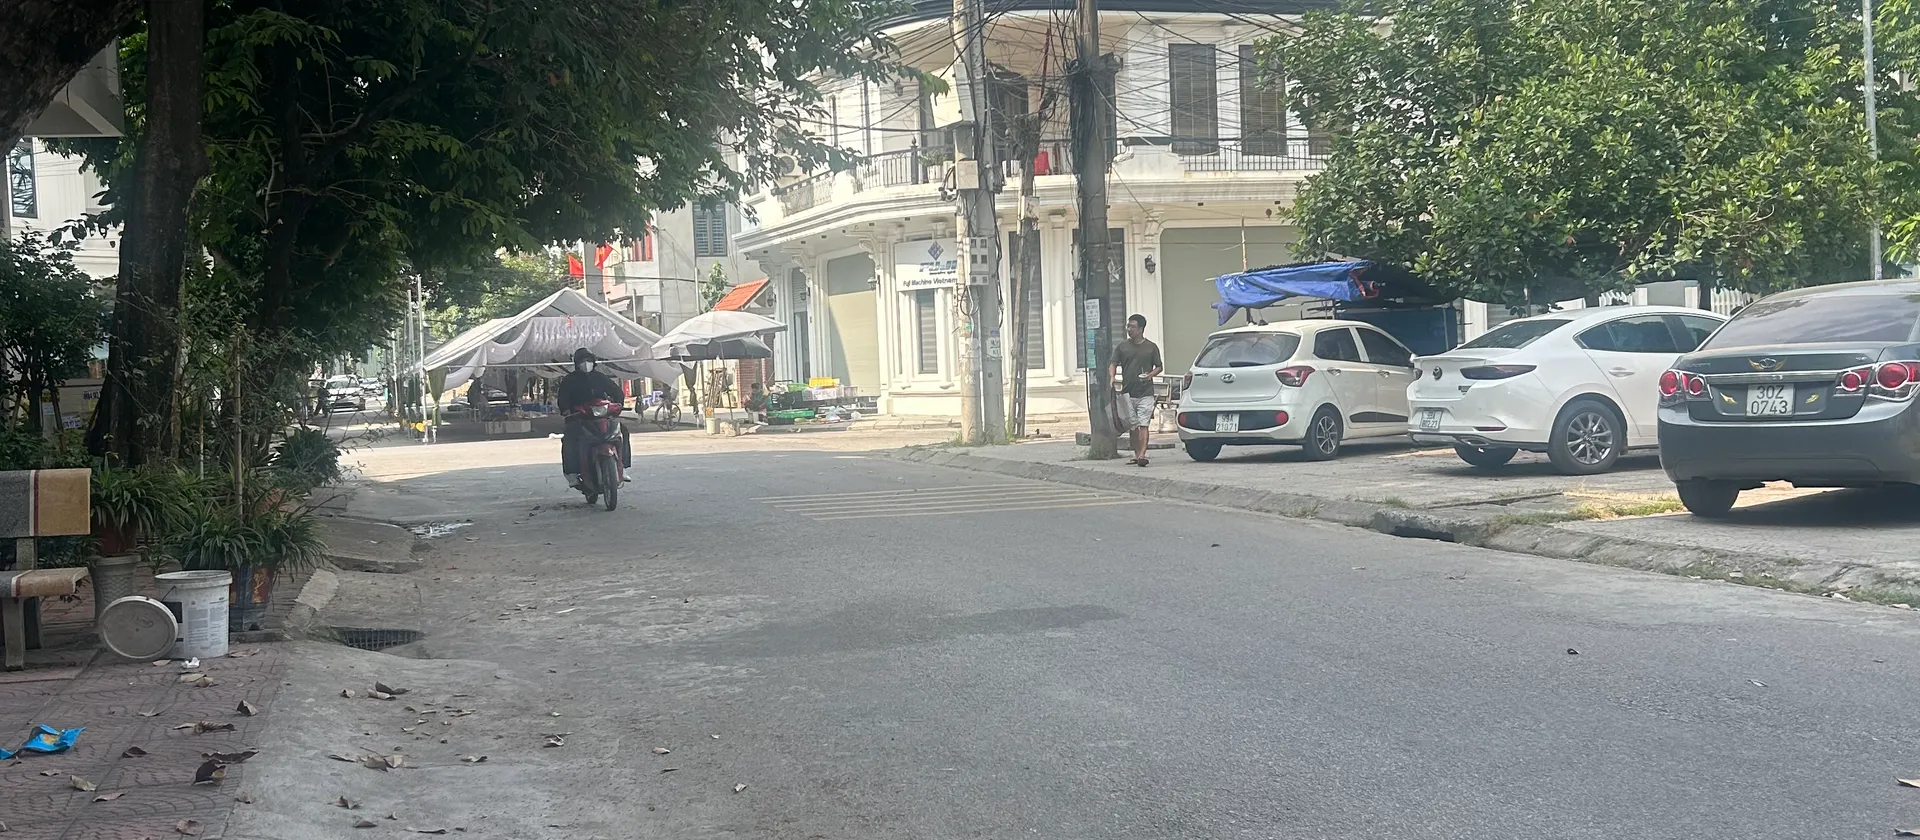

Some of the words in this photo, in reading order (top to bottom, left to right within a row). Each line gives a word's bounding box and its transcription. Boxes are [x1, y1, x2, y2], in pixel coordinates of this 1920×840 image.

[1757, 385, 1785, 400] 30Z
[1751, 400, 1788, 415] 0743
[1221, 414, 1234, 423] 99A
